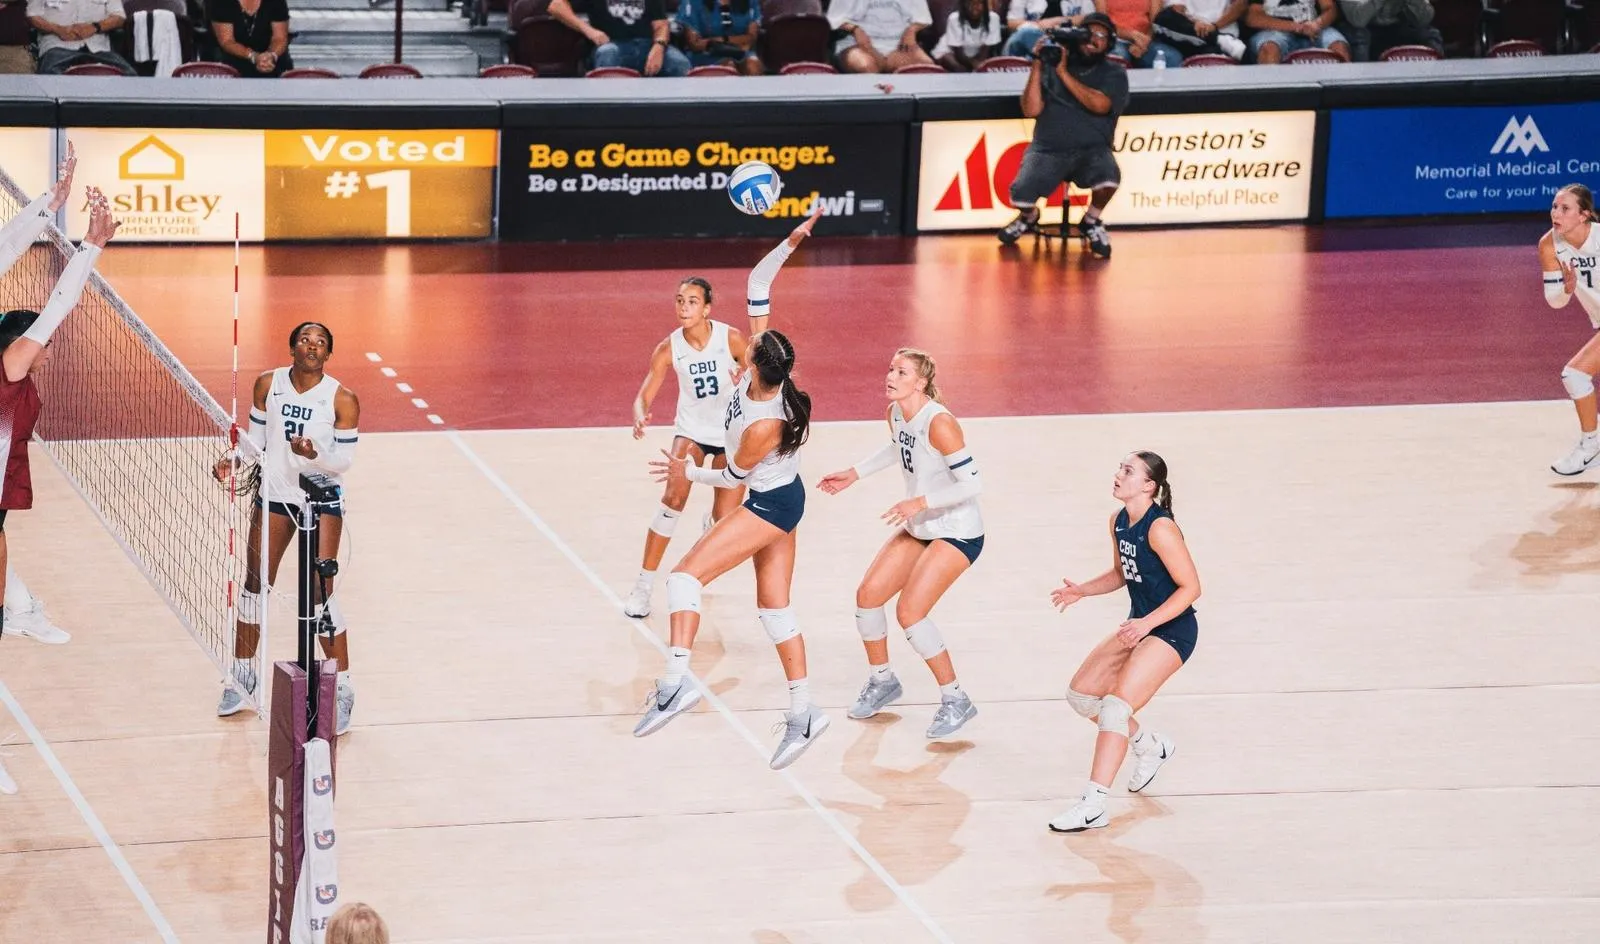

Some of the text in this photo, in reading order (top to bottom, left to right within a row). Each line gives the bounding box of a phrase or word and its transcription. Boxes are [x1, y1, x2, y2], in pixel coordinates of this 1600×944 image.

[302, 136, 465, 162] Voted
[1112, 128, 1267, 153] Johnston's
[529, 142, 835, 171] Be a Game Changer.
[1162, 159, 1301, 181] Hardware
[1415, 163, 1491, 180] Memorial
[1497, 161, 1561, 176] Medical
[528, 174, 558, 192] Be
[561, 177, 577, 192] a
[580, 172, 707, 196] Designated
[1445, 188, 1478, 199] Care
[1483, 186, 1501, 197] for
[1507, 186, 1537, 200] your
[80, 184, 222, 220] shley
[324, 169, 411, 237] #1
[1131, 188, 1280, 210] The Helpful Place
[1570, 257, 1596, 268] CBU
[1580, 270, 1594, 288] 7
[689, 360, 717, 375] CBU
[693, 375, 719, 399] 23
[281, 403, 313, 421] CBU
[284, 420, 305, 442] 21
[899, 430, 916, 449] CBU
[901, 447, 914, 474] 12
[1119, 539, 1137, 557] CBU
[1120, 555, 1143, 583] 22
